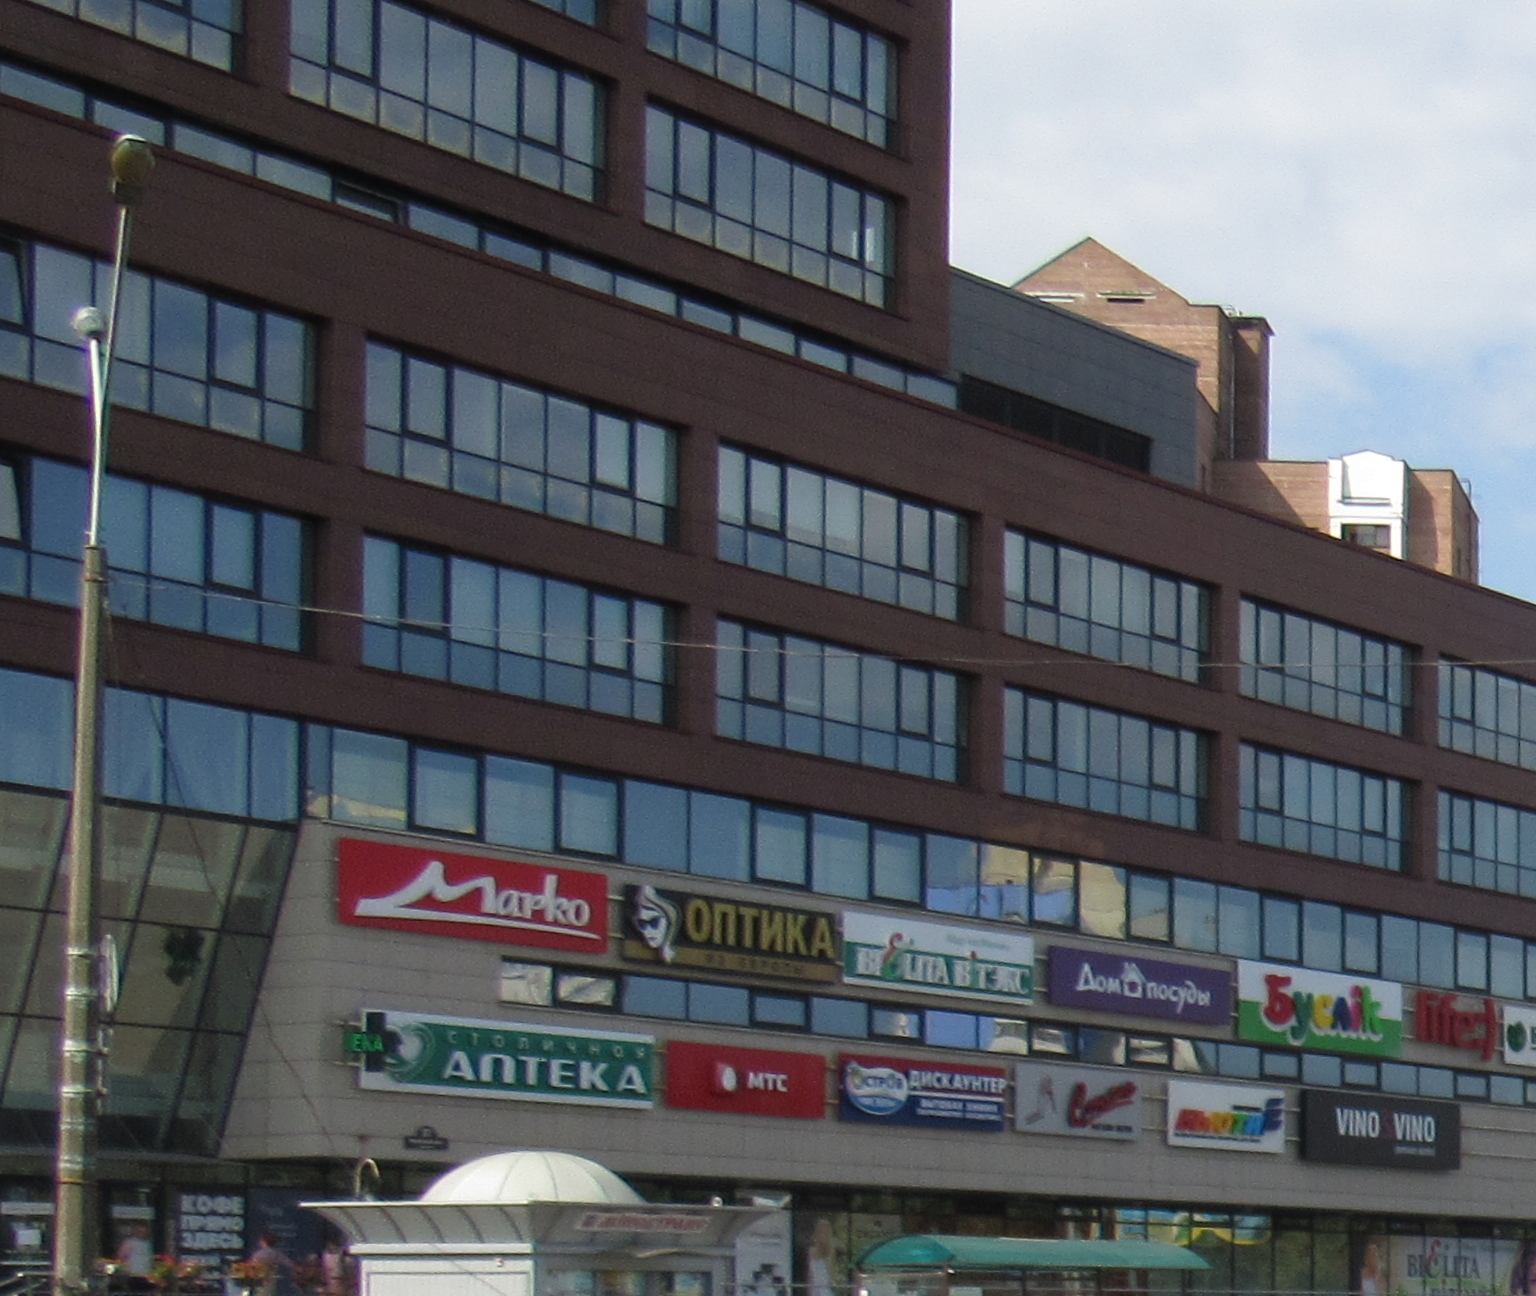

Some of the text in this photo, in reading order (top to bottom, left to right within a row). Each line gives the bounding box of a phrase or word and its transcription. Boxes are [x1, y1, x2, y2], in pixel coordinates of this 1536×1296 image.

[686, 900, 835, 958] ОПТИКА
[1076, 963, 1211, 1014] Дом посуды
[443, 1050, 649, 1095] АПТЕКА
[747, 1071, 789, 1093] МТС
[908, 1069, 1008, 1093] ДИСКАУНТЕР
[1335, 1107, 1381, 1138] VINO
[1393, 1113, 1437, 1143] VINO
